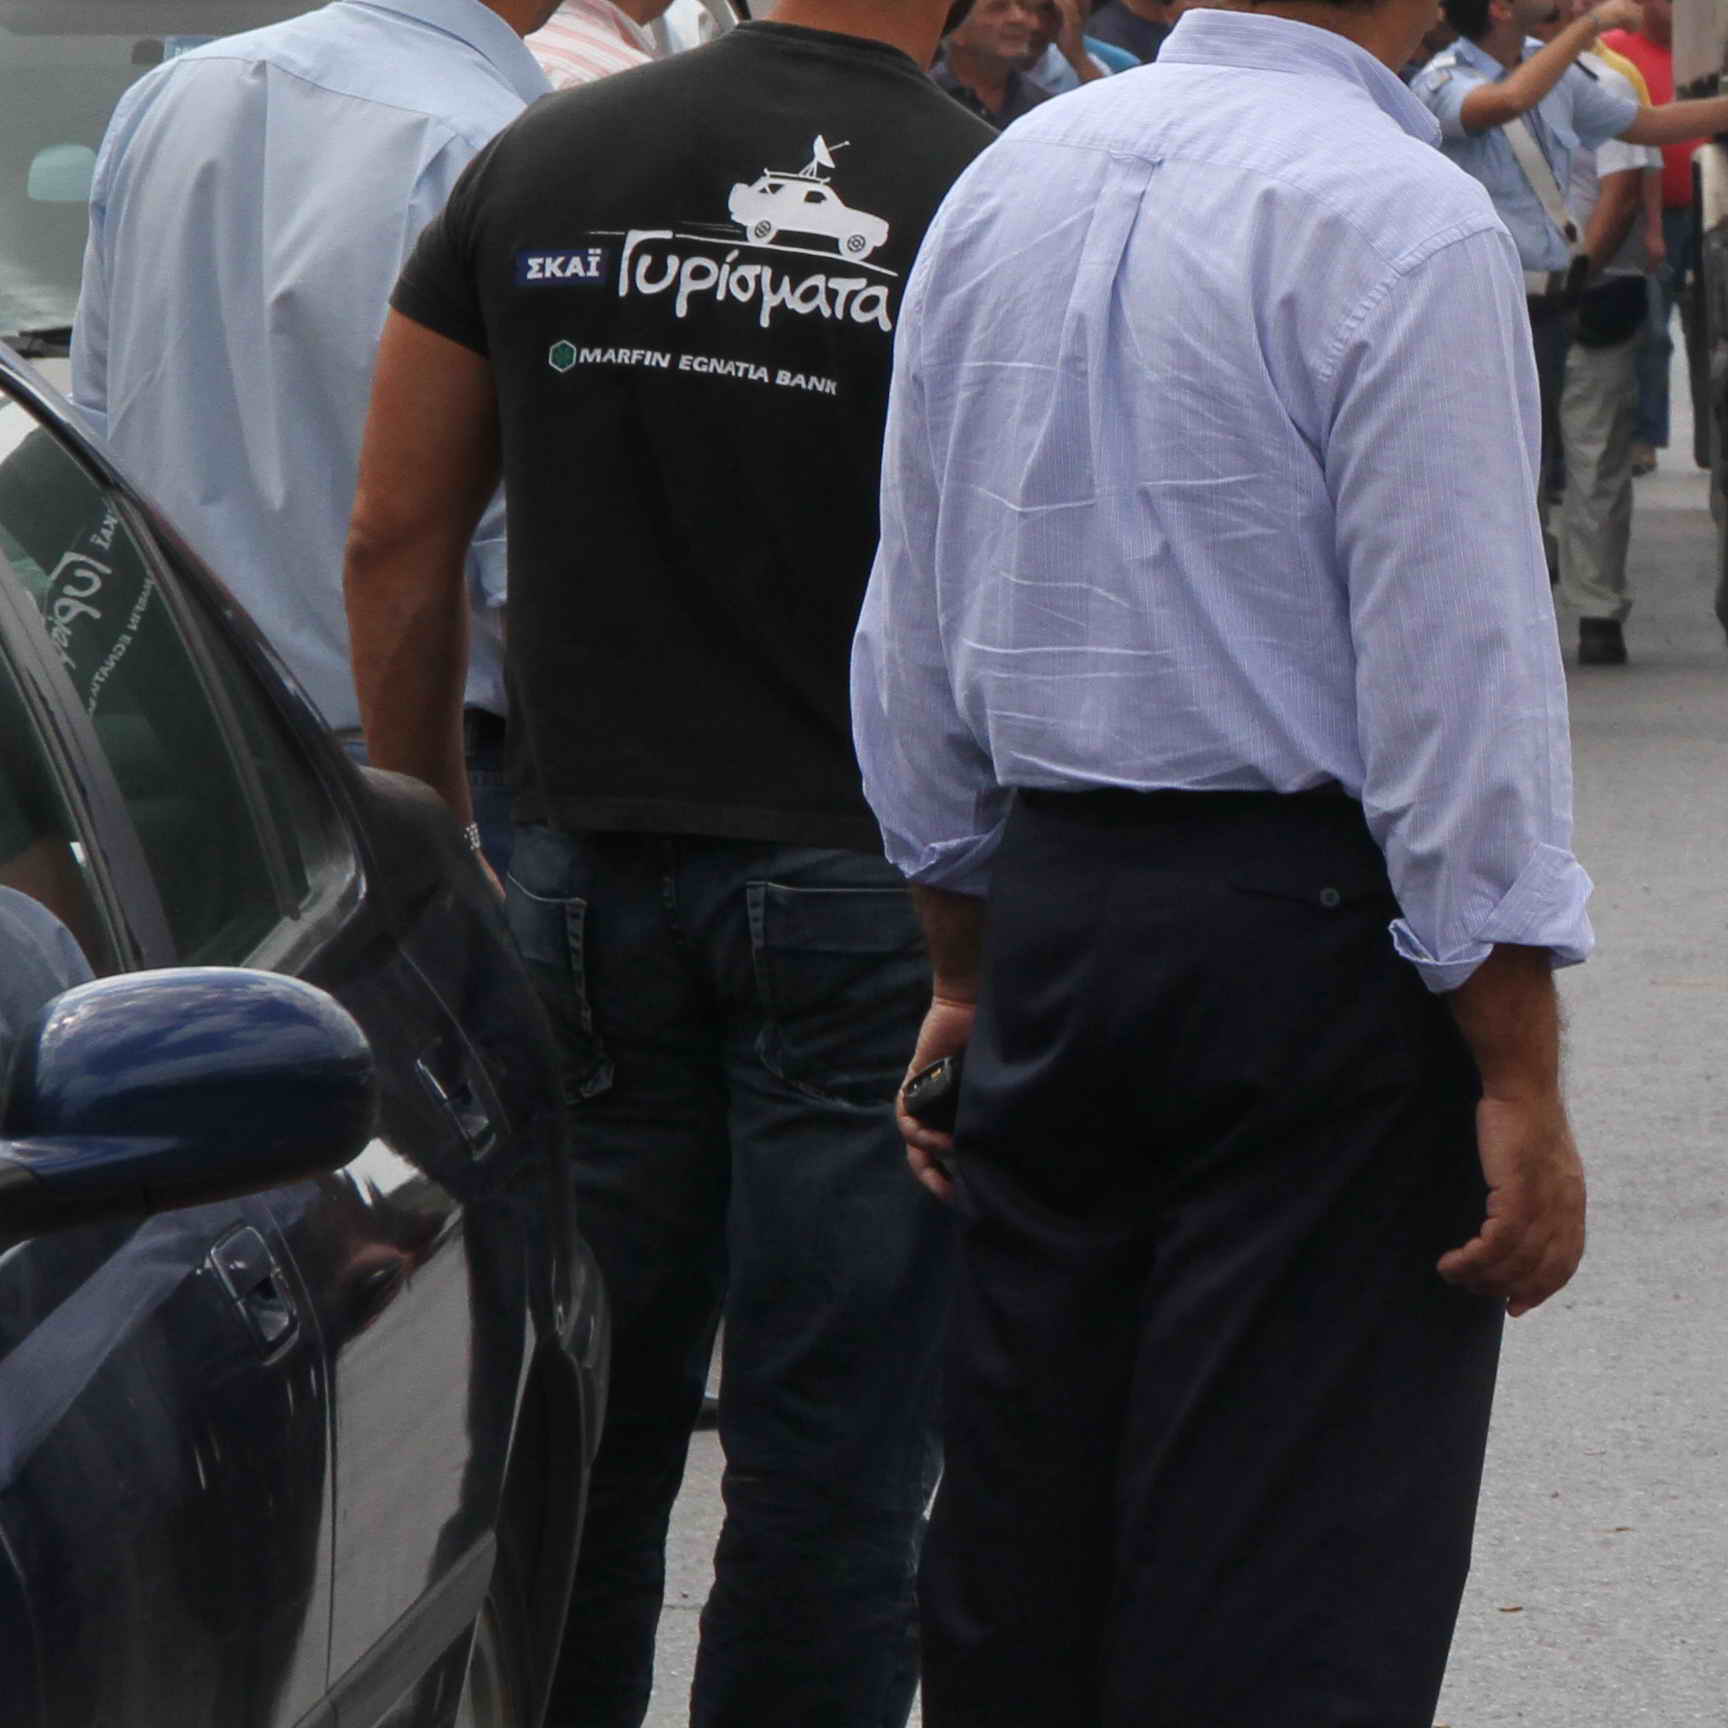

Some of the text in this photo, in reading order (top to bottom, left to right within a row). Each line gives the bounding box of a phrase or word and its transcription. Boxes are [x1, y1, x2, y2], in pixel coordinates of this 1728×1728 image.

[526, 229, 893, 332] ΣΚΑΪ Γυρίσματα
[579, 347, 838, 397] MARFIN EGNATIA BANK
